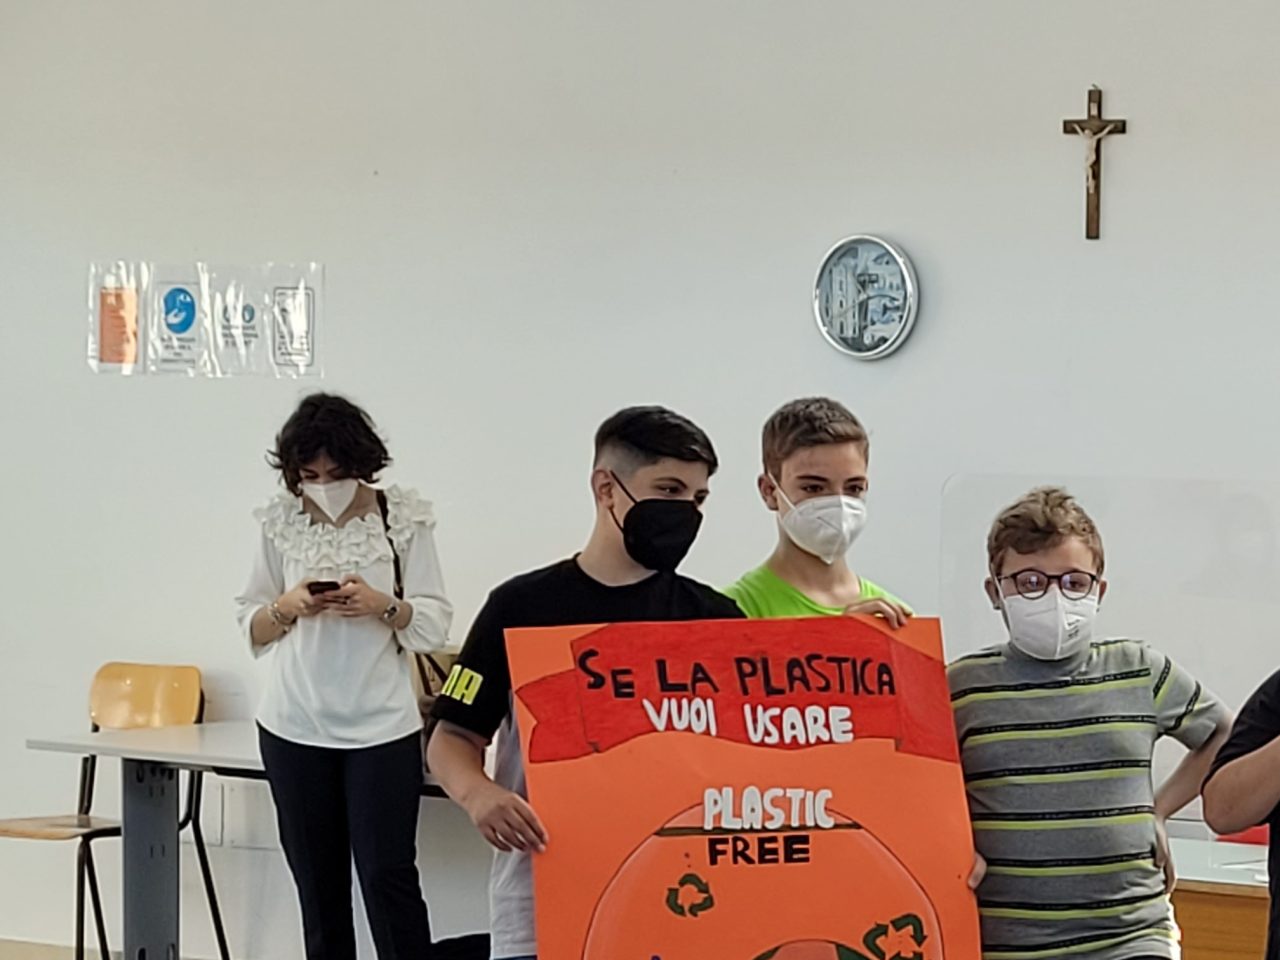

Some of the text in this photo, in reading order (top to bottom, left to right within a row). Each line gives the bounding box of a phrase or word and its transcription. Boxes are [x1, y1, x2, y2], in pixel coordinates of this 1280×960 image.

[578, 649, 896, 698] SE LA PLASTICA
[643, 698, 854, 744] VUOI USARE
[704, 786, 835, 830] PLASTIC
[708, 835, 810, 866] FREE
